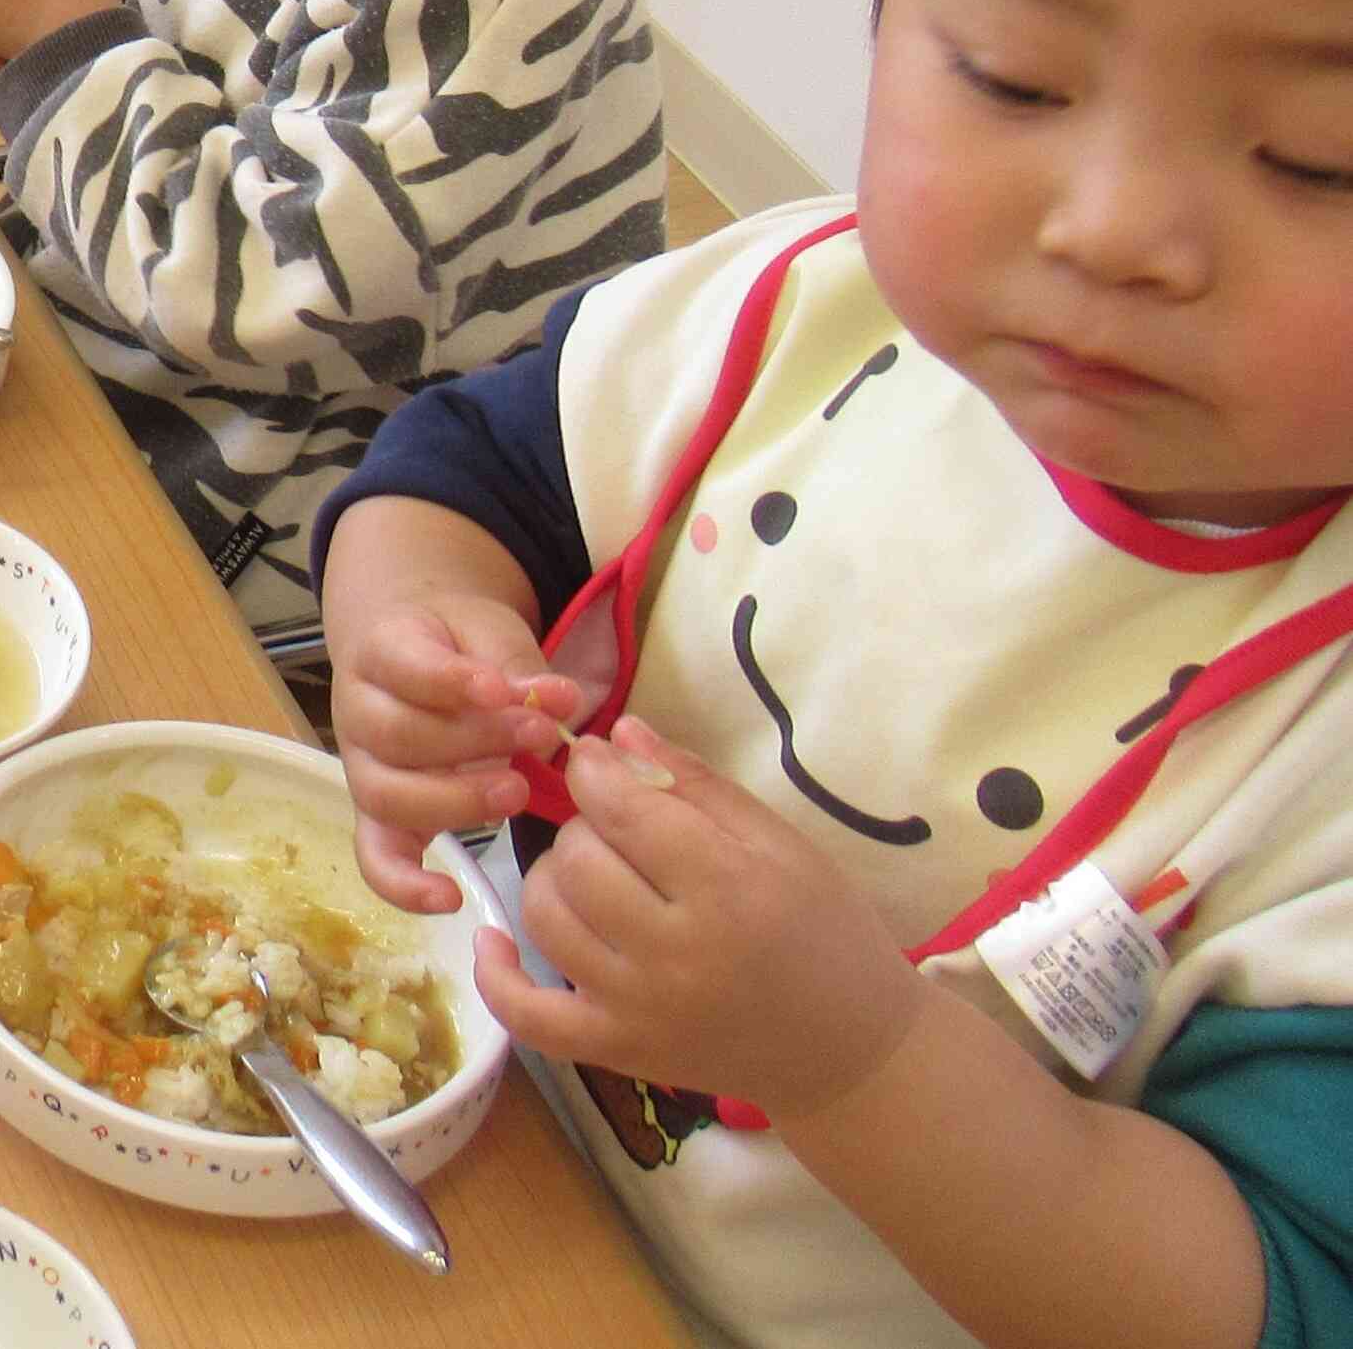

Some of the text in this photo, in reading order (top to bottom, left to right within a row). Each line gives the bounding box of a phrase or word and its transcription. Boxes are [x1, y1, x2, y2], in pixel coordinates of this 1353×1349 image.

[13, 563, 24, 579] S
[40, 576, 51, 593] T
[4, 1069, 17, 1083] P
[43, 1092, 64, 1117] Q
[91, 1124, 109, 1141] R
[136, 1146, 152, 1164] S
[183, 1152, 200, 1167] T
[230, 1169, 250, 1183] U
[288, 1156, 305, 1174] V
[43, 1266, 59, 1285] O
[69, 1307, 82, 1322] P
